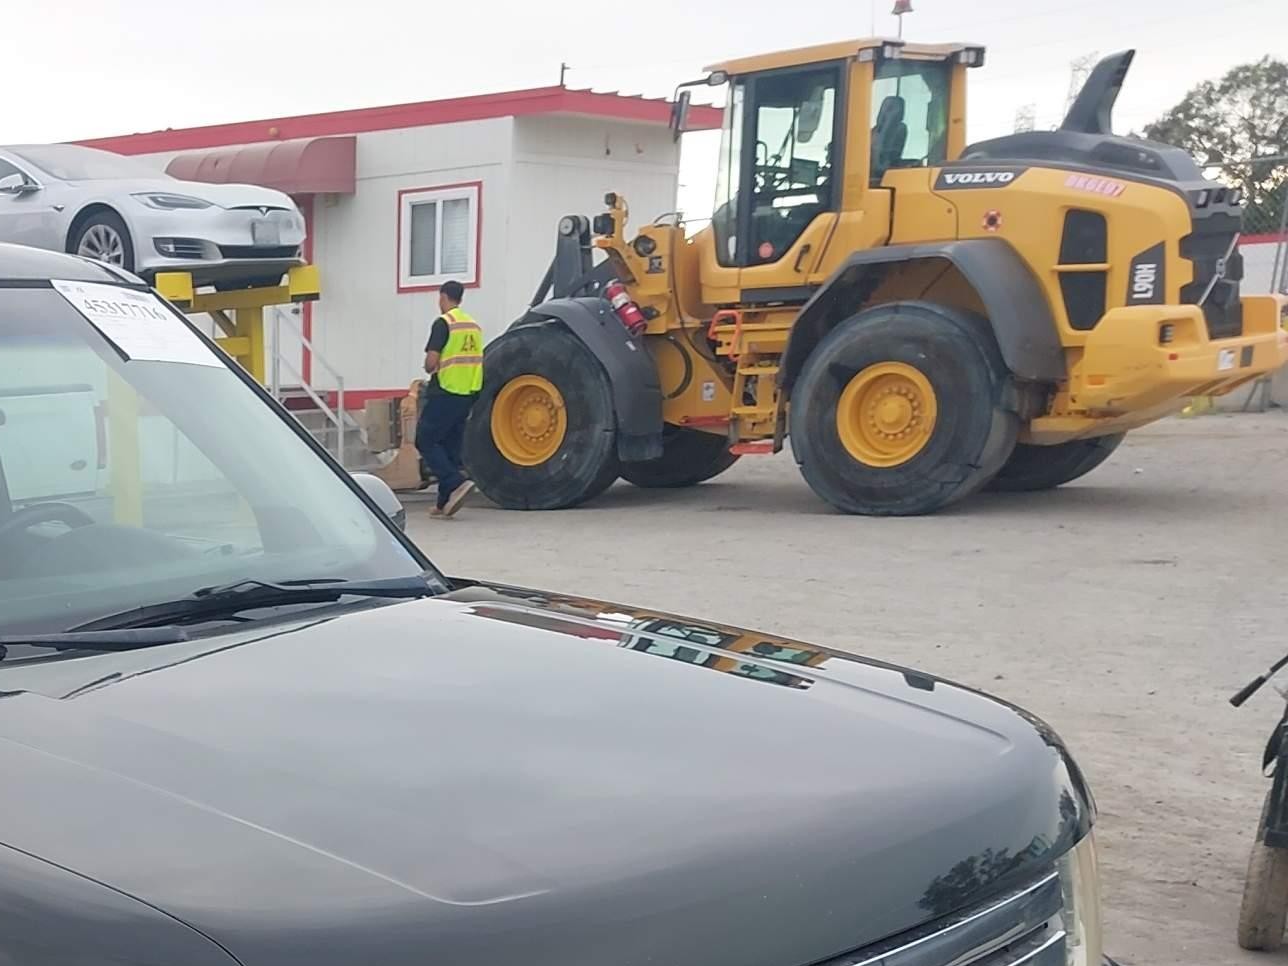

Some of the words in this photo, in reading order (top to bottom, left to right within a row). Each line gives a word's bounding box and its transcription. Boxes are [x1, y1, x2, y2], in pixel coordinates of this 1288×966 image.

[944, 171, 1015, 184] VOLVO
[1132, 263, 1158, 299] L90H
[83, 298, 168, 321] 45317716
